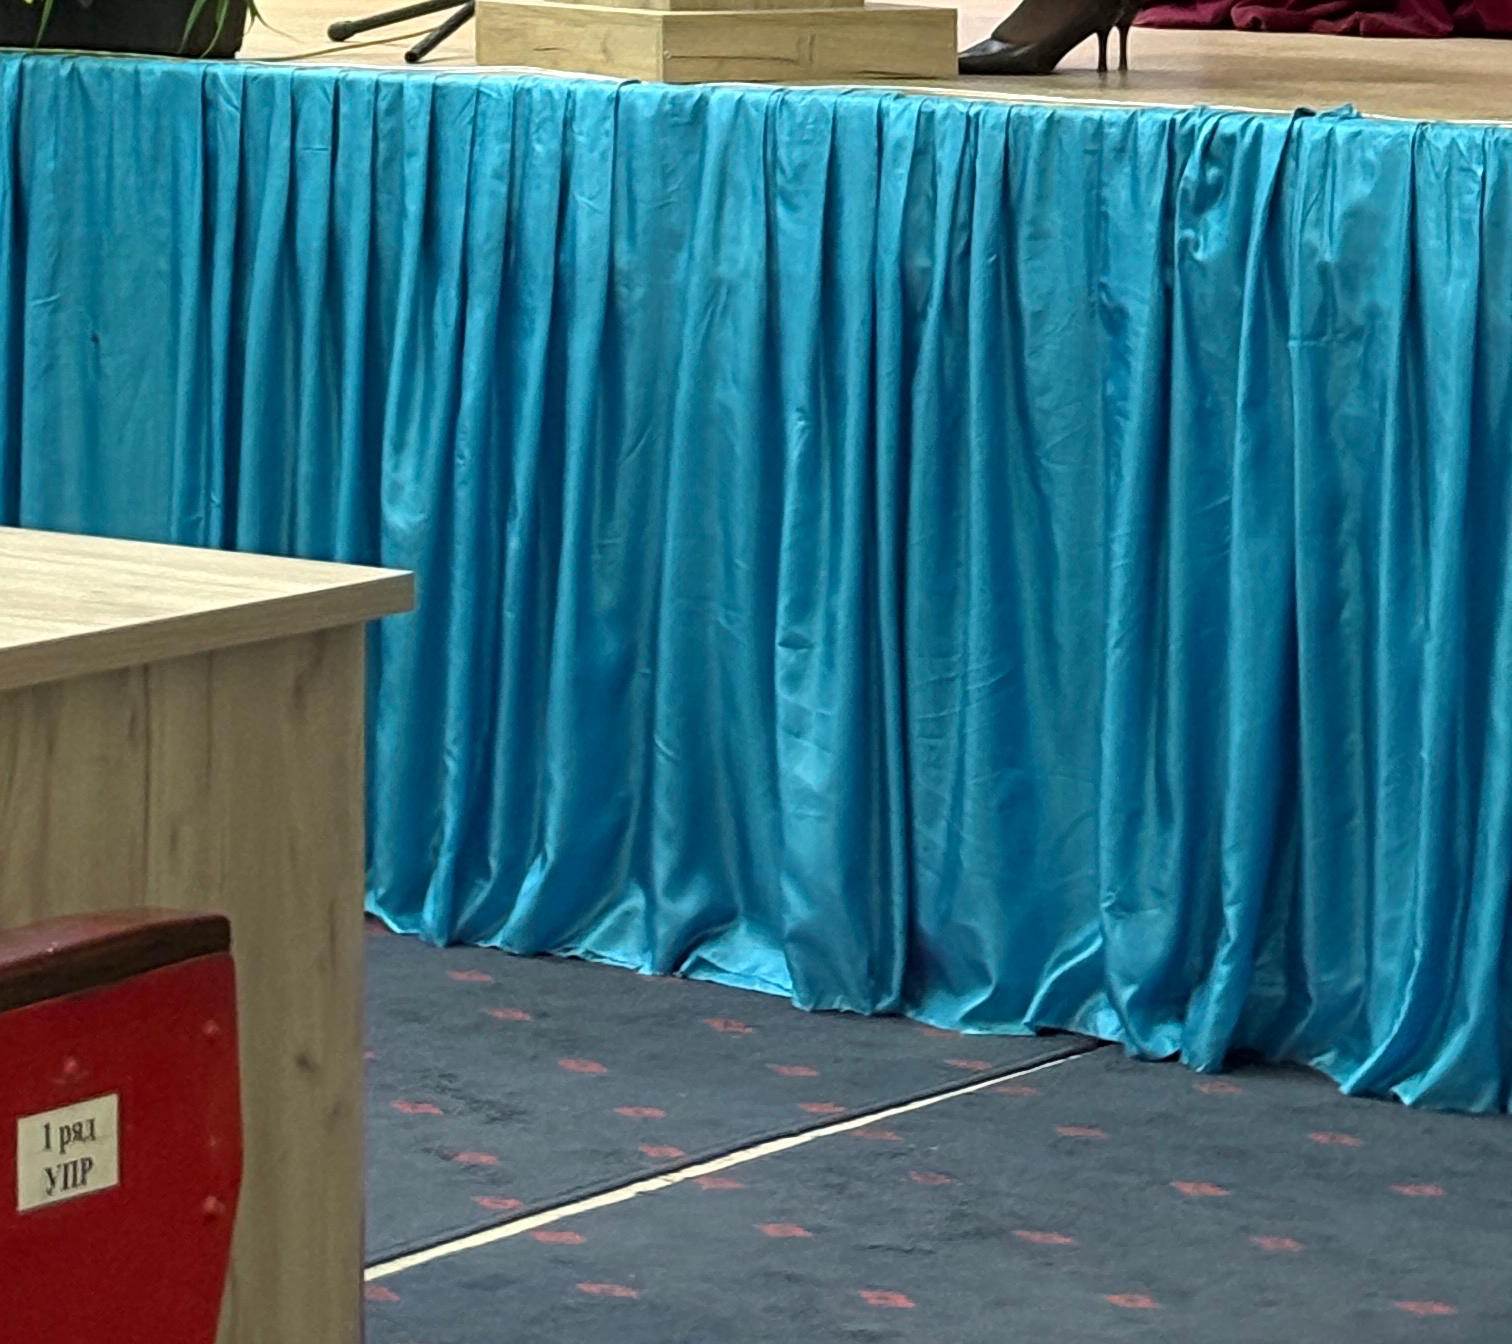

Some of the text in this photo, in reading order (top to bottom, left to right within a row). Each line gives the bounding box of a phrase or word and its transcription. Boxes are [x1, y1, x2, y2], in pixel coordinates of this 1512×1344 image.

[41, 1117, 97, 1155] 1 ряд
[44, 1156, 95, 1196] УПР
